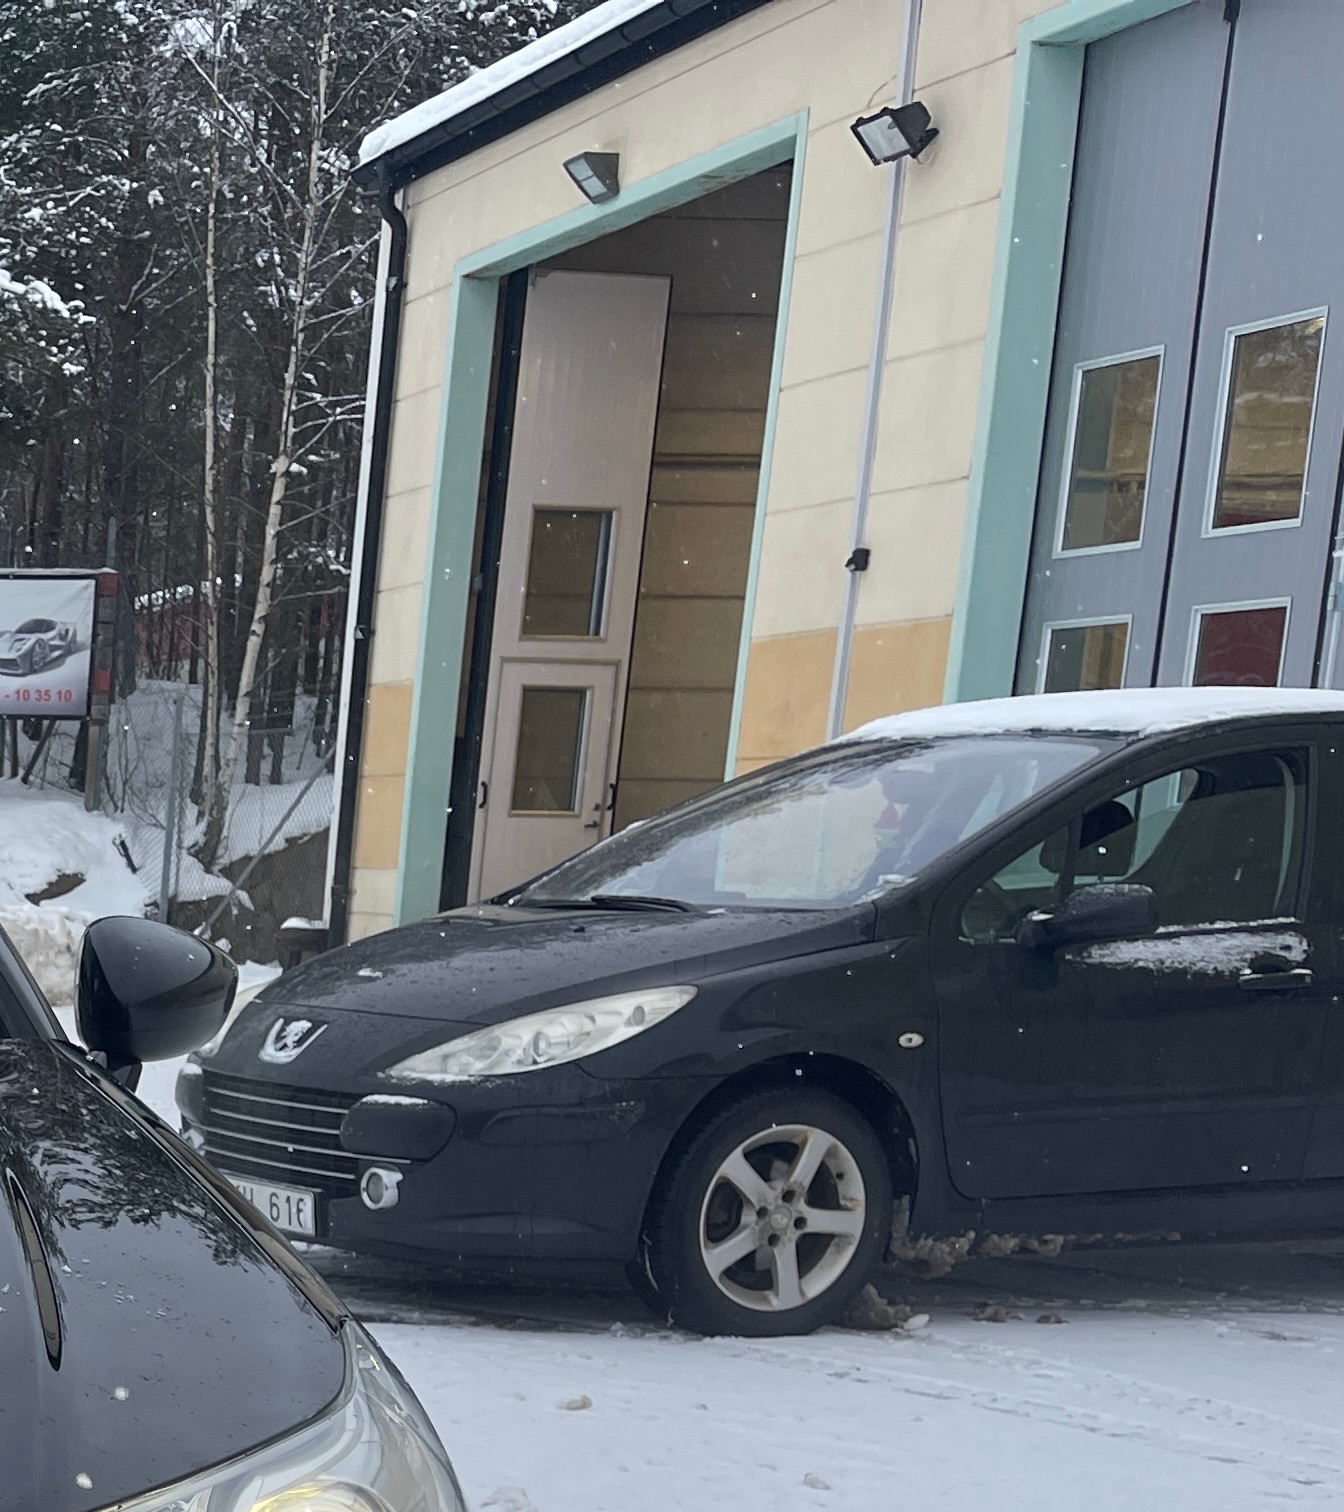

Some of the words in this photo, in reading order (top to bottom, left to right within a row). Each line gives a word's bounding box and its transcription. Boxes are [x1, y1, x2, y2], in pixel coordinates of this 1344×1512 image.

[14, 688, 31, 702] 10
[34, 689, 52, 702] 35
[56, 689, 73, 703] 10
